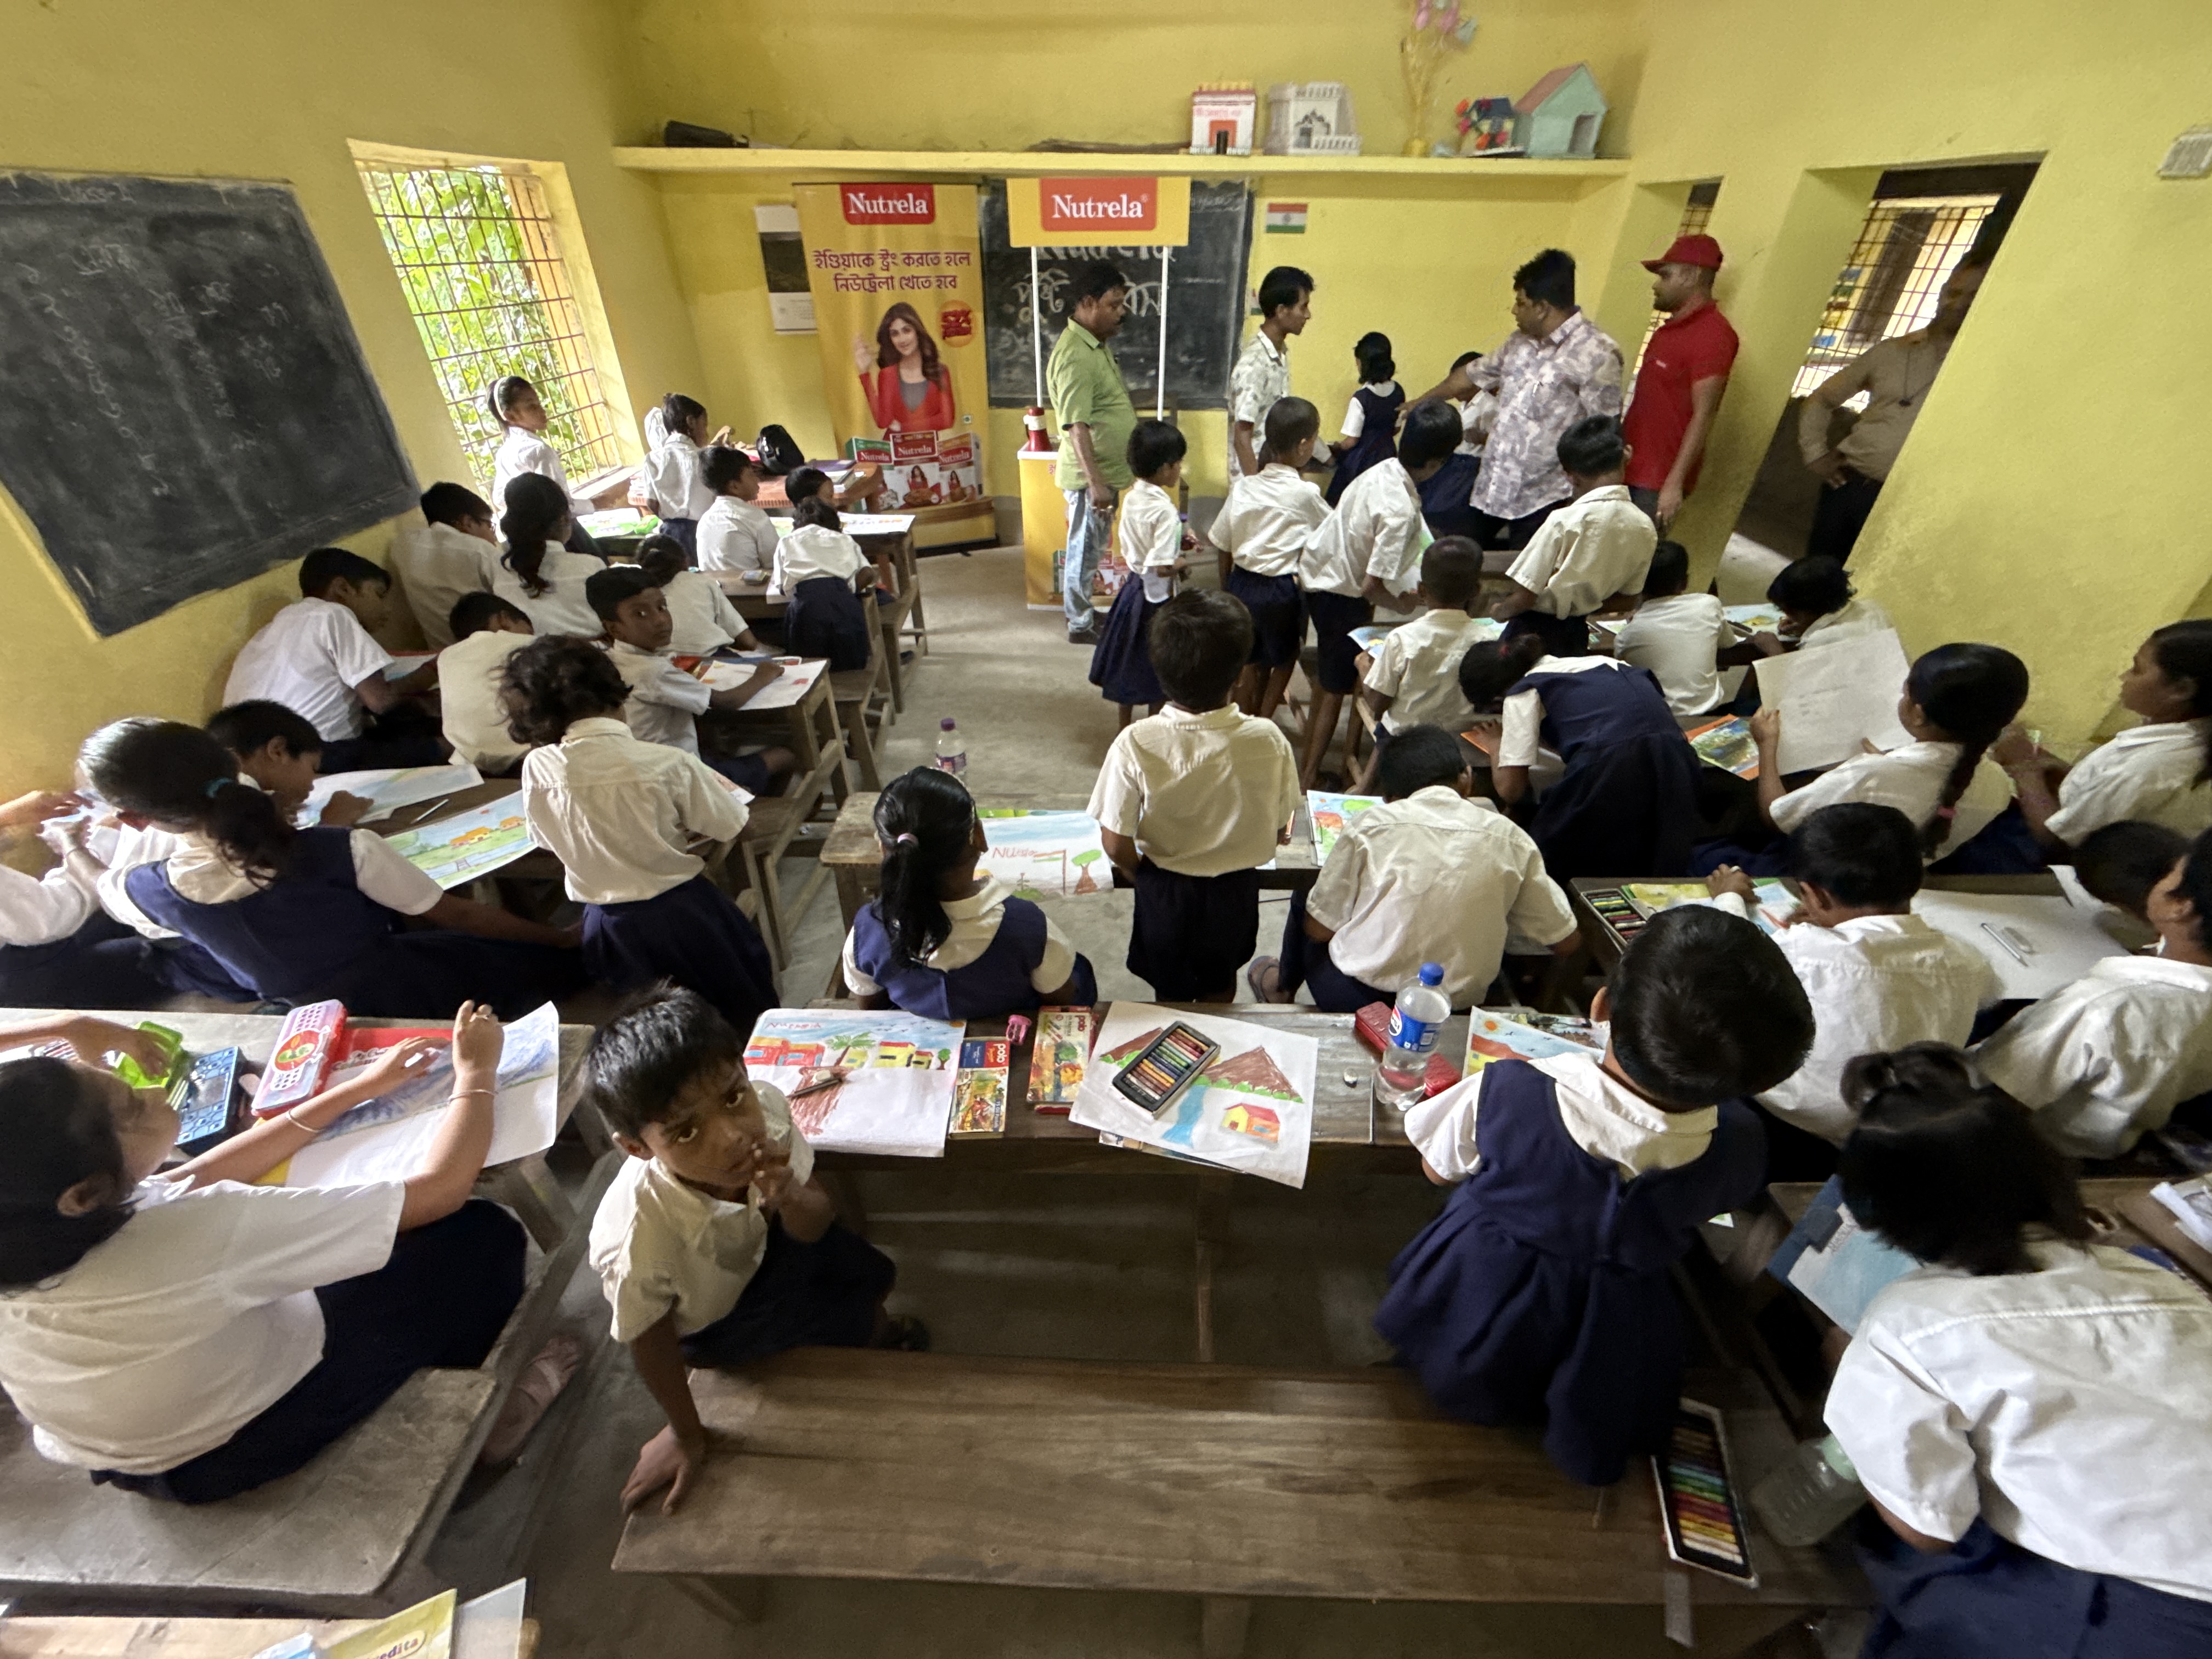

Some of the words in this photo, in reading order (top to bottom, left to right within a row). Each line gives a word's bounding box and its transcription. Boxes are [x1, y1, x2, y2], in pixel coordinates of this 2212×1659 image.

[848, 193, 928, 215] Nutrela
[1051, 194, 1143, 218] Nutrela
[901, 252, 940, 267] করতে
[944, 252, 970, 266] হলে
[900, 275, 932, 290] খেতে
[935, 275, 957, 289] হবে
[860, 452, 890, 461] Nutrela
[898, 445, 932, 456] Nutrela
[993, 1043, 1007, 1063] polo
